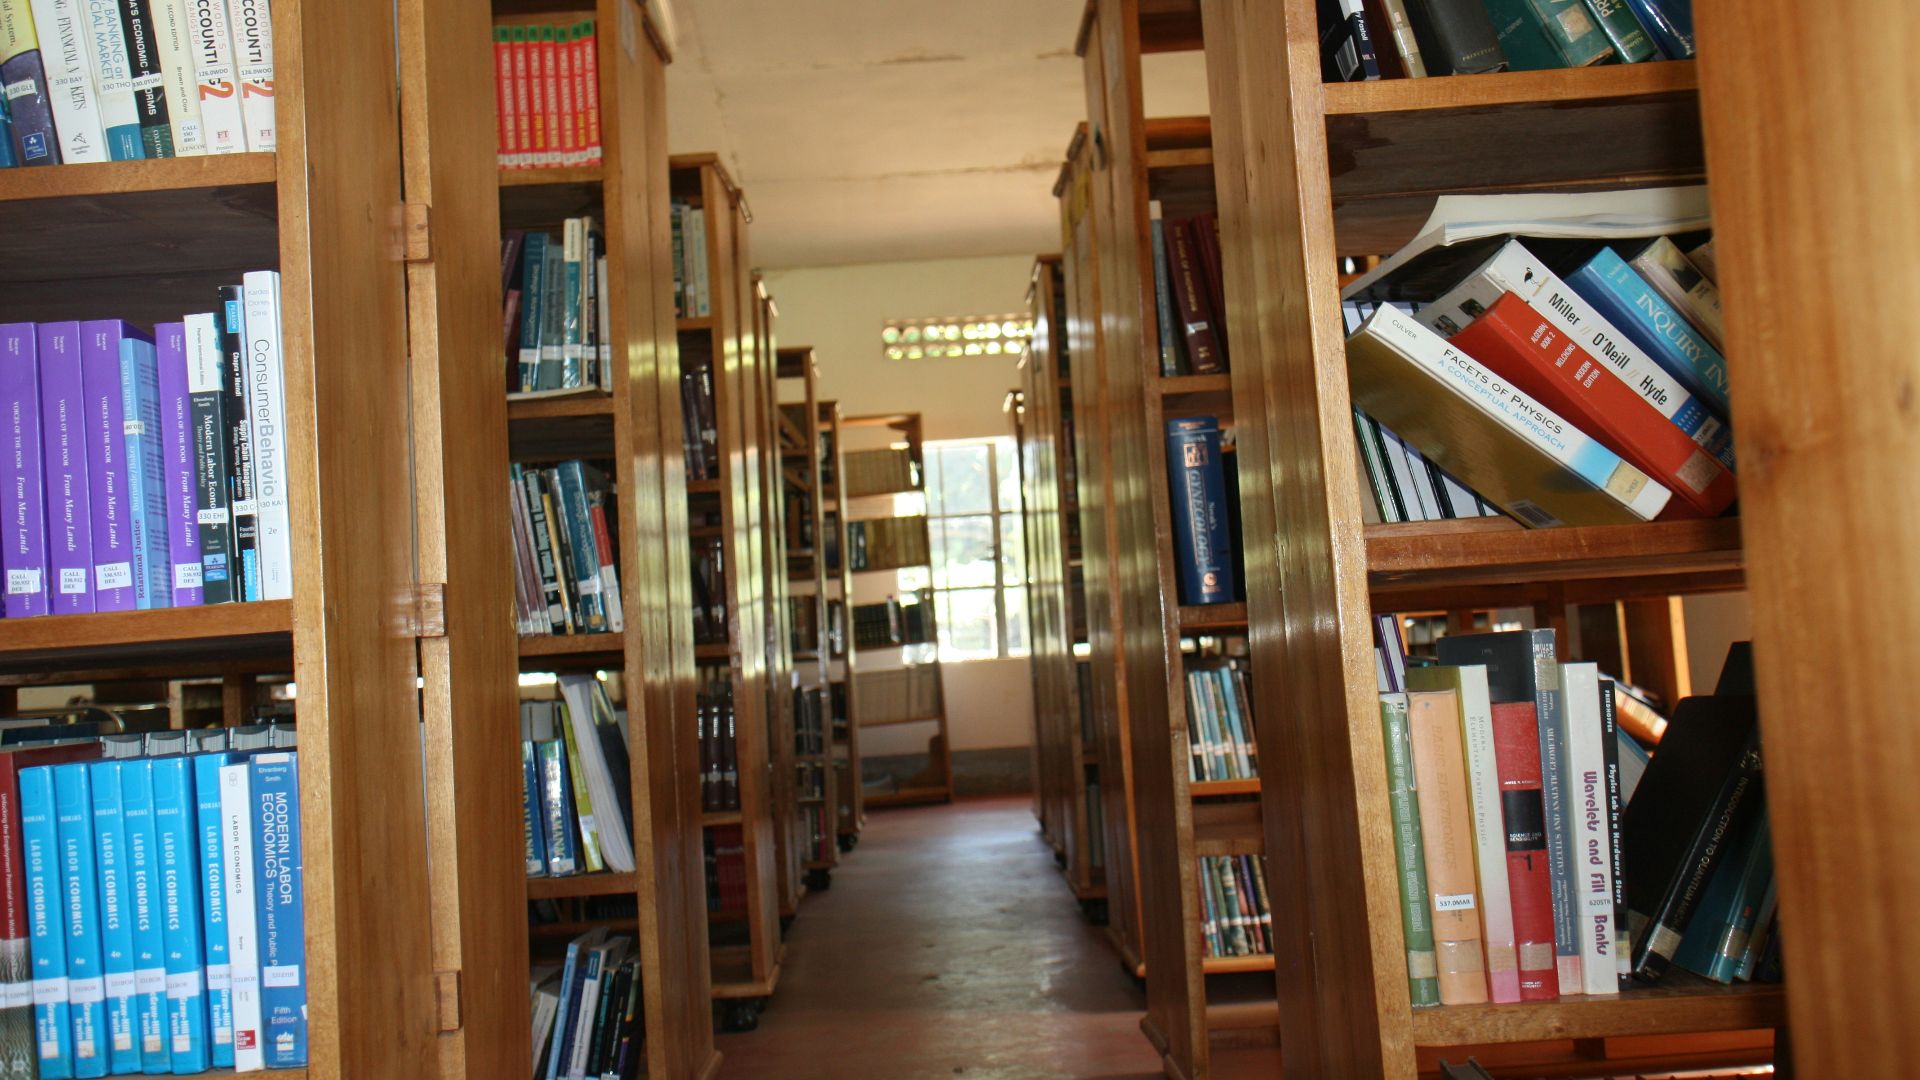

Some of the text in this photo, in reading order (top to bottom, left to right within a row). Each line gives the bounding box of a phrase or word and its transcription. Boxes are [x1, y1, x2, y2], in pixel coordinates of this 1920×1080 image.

[103, 9, 124, 63] BANKING
[167, 4, 180, 52] SECOND EDITION
[187, 1, 201, 46] SANGSTER
[212, 2, 227, 50] WOOD'S
[230, 0, 245, 43] SANGSTER
[57, 16, 79, 65] FINANCIAL
[88, 0, 115, 80] CIAL MARKET
[131, 18, 149, 68] ECONOMIC
[55, 76, 84, 86] 330 BAY
[116, 81, 131, 90] THO
[176, 66, 184, 86] Brown
[198, 81, 234, 101] 2
[242, 80, 274, 99] 2
[179, 87, 188, 97] and
[1392, 318, 1418, 340] CULVER
[1635, 292, 1709, 364] INQUIRY
[1548, 292, 1669, 406] Miller O'Neill Hyde
[232, 351, 243, 397] Chapra Meindl
[1582, 368, 1601, 390] EDITION
[1438, 359, 1567, 452] A CONCEPTUAL APPROACH
[1443, 348, 1563, 435] FACETS OF PHYSICS
[14, 425, 20, 435] OF
[60, 423, 67, 433] OF
[102, 420, 109, 429] OF
[177, 420, 184, 429] OF
[61, 448, 69, 467] POOR
[104, 445, 112, 464] POOR
[179, 444, 187, 463] POOR
[239, 419, 254, 501] Supply Chain Managemen
[16, 476, 26, 499] From
[63, 473, 73, 496] From
[106, 471, 116, 494] From
[180, 470, 191, 493] From
[199, 472, 207, 488] Policy
[203, 414, 218, 530] Modern Labor Econocs
[16, 501, 27, 526] Many
[63, 498, 75, 523] Many
[106, 496, 119, 521] Many
[181, 495, 193, 519] Many
[19, 528, 29, 554] Lands
[65, 525, 77, 552] Lands
[108, 522, 120, 549] Lands
[184, 520, 196, 548] Lands
[133, 519, 146, 599] Relational Justice
[1604, 689, 1614, 733] FRIEDHOFFER
[1477, 715, 1487, 751] MODERN
[1469, 716, 1488, 847] ELEMENTARY PARTICLE PHYSICS
[1609, 763, 1619, 794] Physics
[0, 792, 8, 824] Unlocking
[1547, 727, 1565, 876] CALCULUS AND ANALYTIC GEOMETRY
[1583, 770, 1600, 833] Wavelets
[1611, 795, 1619, 810] Lab
[3, 834, 11, 872] Employment
[232, 814, 245, 895] LABOR ECONOMICS
[275, 792, 292, 905] MODERN LABOR
[1588, 838, 1604, 866] and
[1612, 832, 1622, 876] Hardware
[1682, 775, 1750, 905] INTRODUCTION TO QUANTUM
[5, 873, 13, 900] Potential
[29, 838, 48, 938] LABOR ECONOMICS
[66, 838, 85, 937] LABOR ECONOMICS
[101, 832, 121, 930] LABOR ECONOMICS
[132, 833, 152, 932] LABOR ECONOMICS
[163, 832, 182, 931] LABOR ECONOMICS
[206, 825, 225, 924] LABOR ECONOMICS
[262, 793, 279, 958] ECONOMICS Theory and Public
[1615, 879, 1623, 904] Store
[1594, 915, 1610, 956] Banks
[271, 1015, 298, 1026] Edition
[273, 1006, 292, 1015] Fifth
